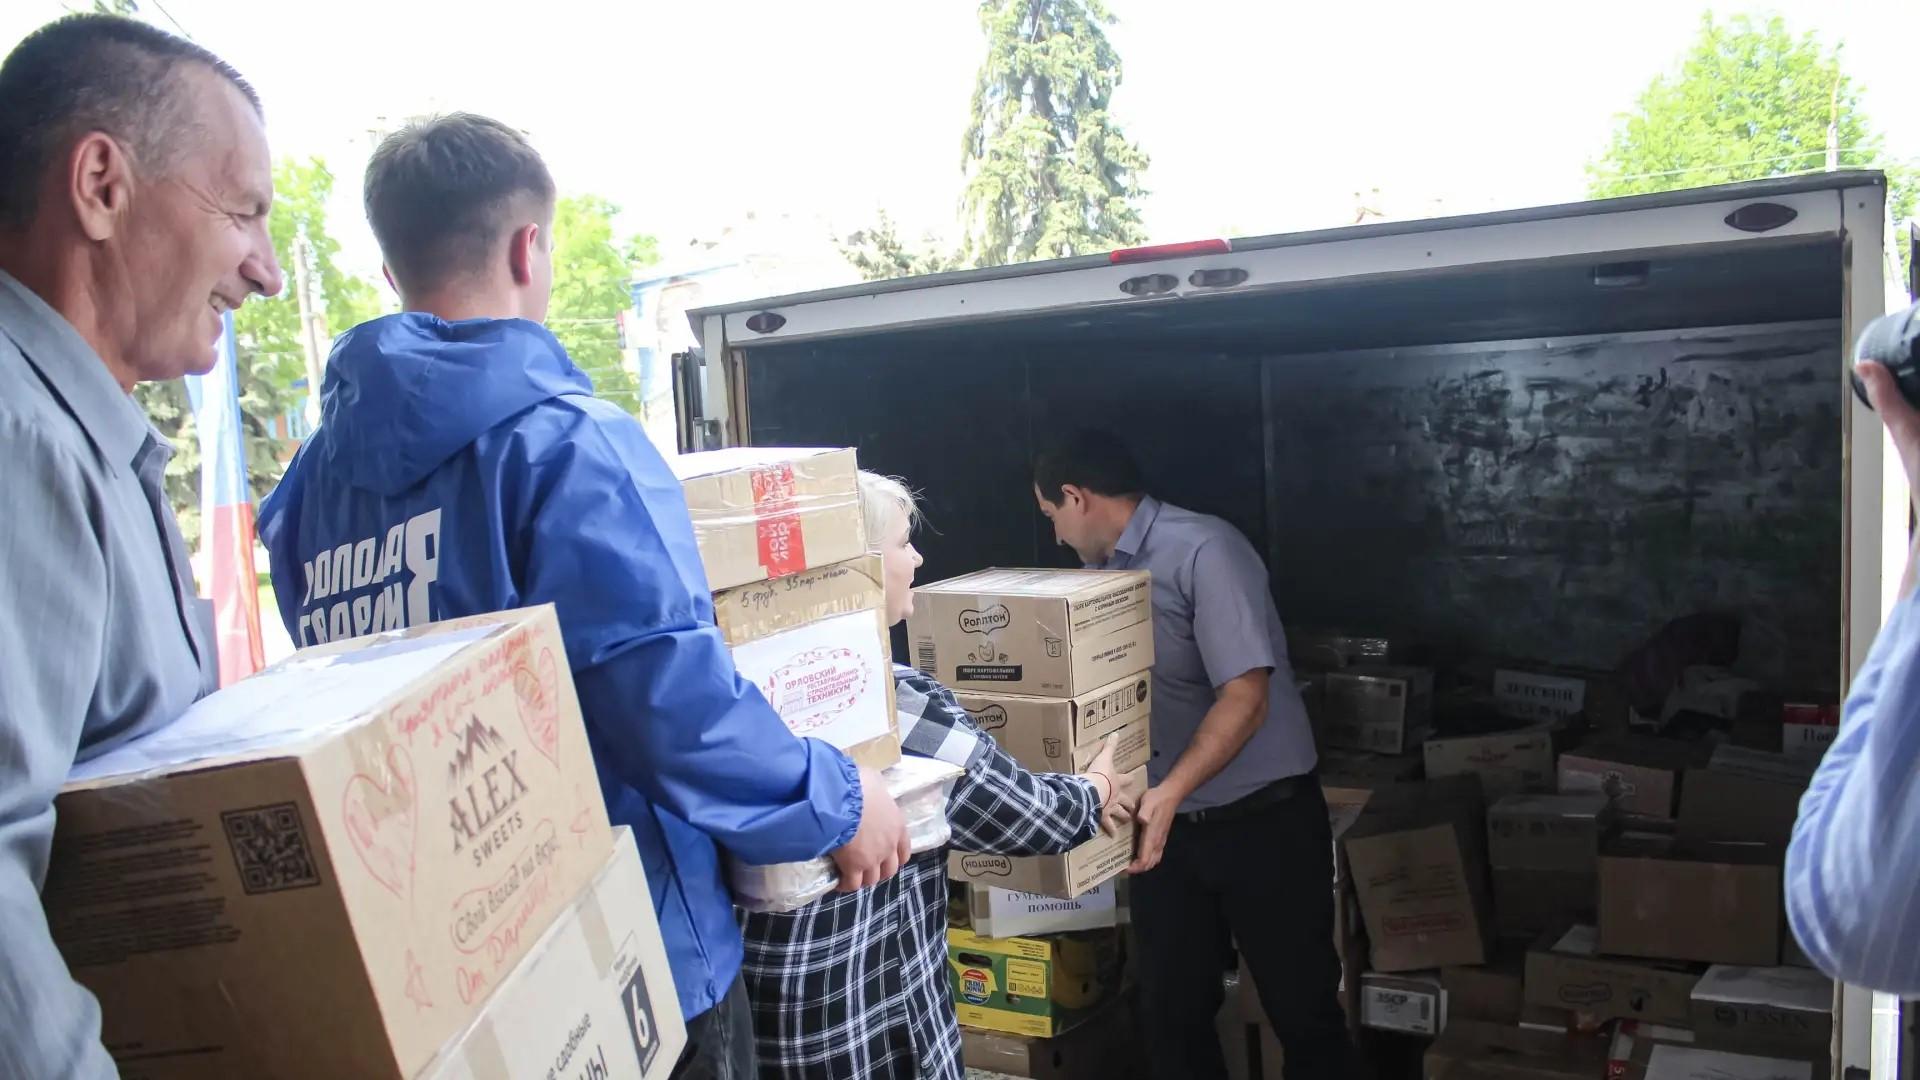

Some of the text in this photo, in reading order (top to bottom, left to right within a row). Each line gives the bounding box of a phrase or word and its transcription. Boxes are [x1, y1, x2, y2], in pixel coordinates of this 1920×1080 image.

[785, 666, 837, 690] ОРЛОВСКИЙ
[808, 684, 851, 705] ТЕХНИКУМ
[449, 749, 529, 855] ALEX
[472, 811, 524, 868] SWEETS
[1028, 901, 1082, 913] ПОМОЩЬ
[555, 1013, 592, 1072] сдобные
[632, 984, 650, 1049] 6
